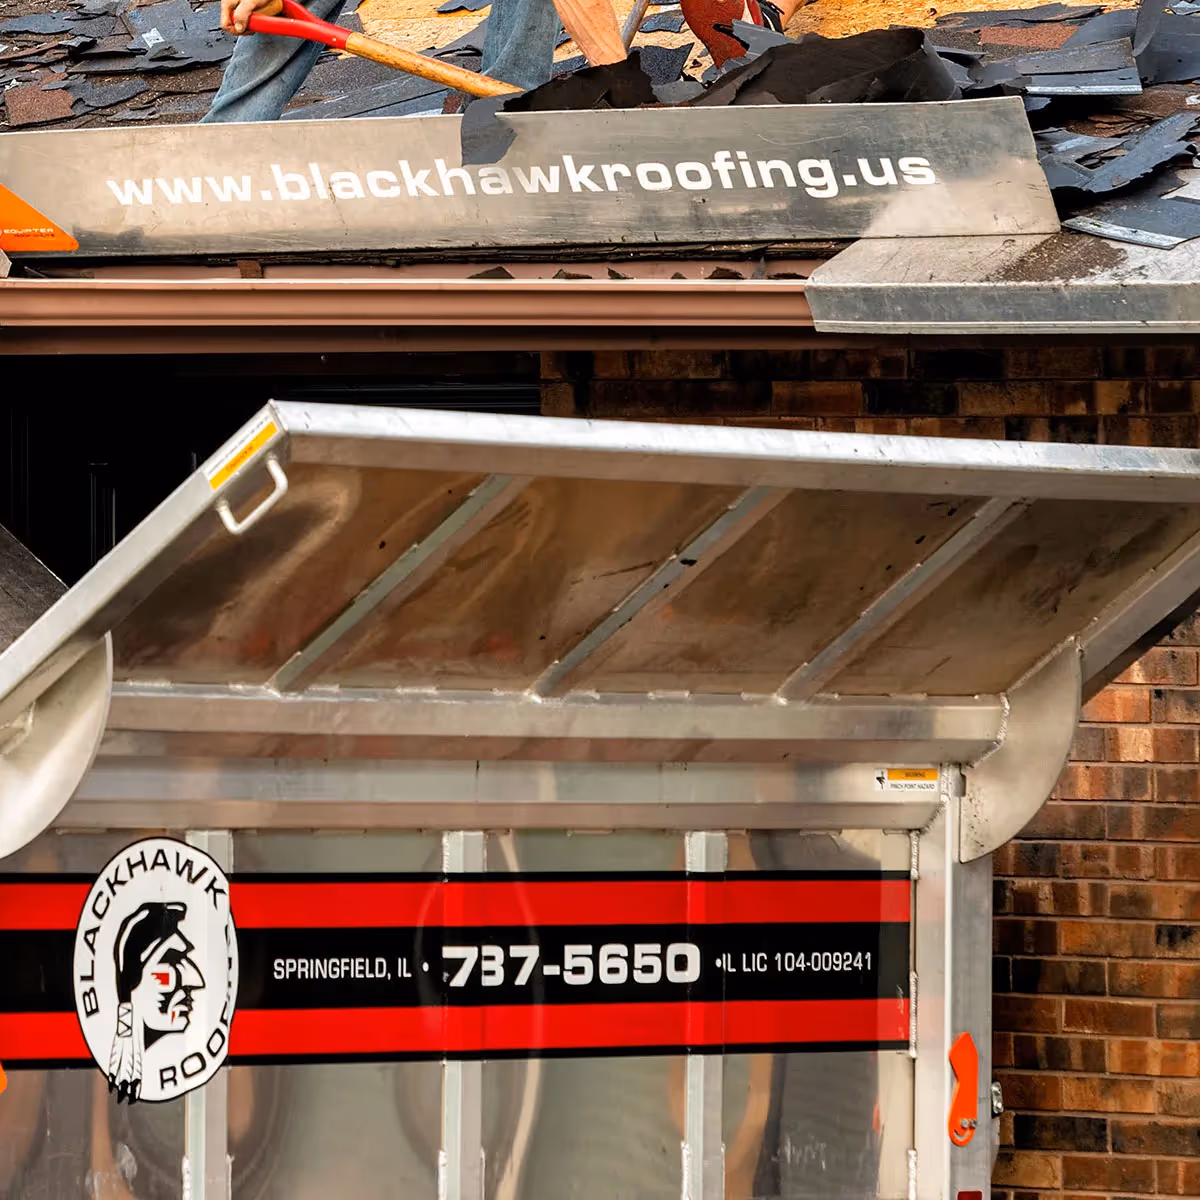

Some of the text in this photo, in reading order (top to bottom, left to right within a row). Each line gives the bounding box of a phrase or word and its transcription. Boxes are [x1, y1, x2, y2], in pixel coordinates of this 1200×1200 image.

[106, 151, 937, 205] www.blackhawkroofing.us
[80, 849, 227, 1018] BLACKHAWK
[273, 957, 412, 980] SPRINGFIELD, IL
[441, 942, 701, 987] 737-5650
[742, 952, 768, 972] LIC
[774, 951, 872, 972] 104-009241
